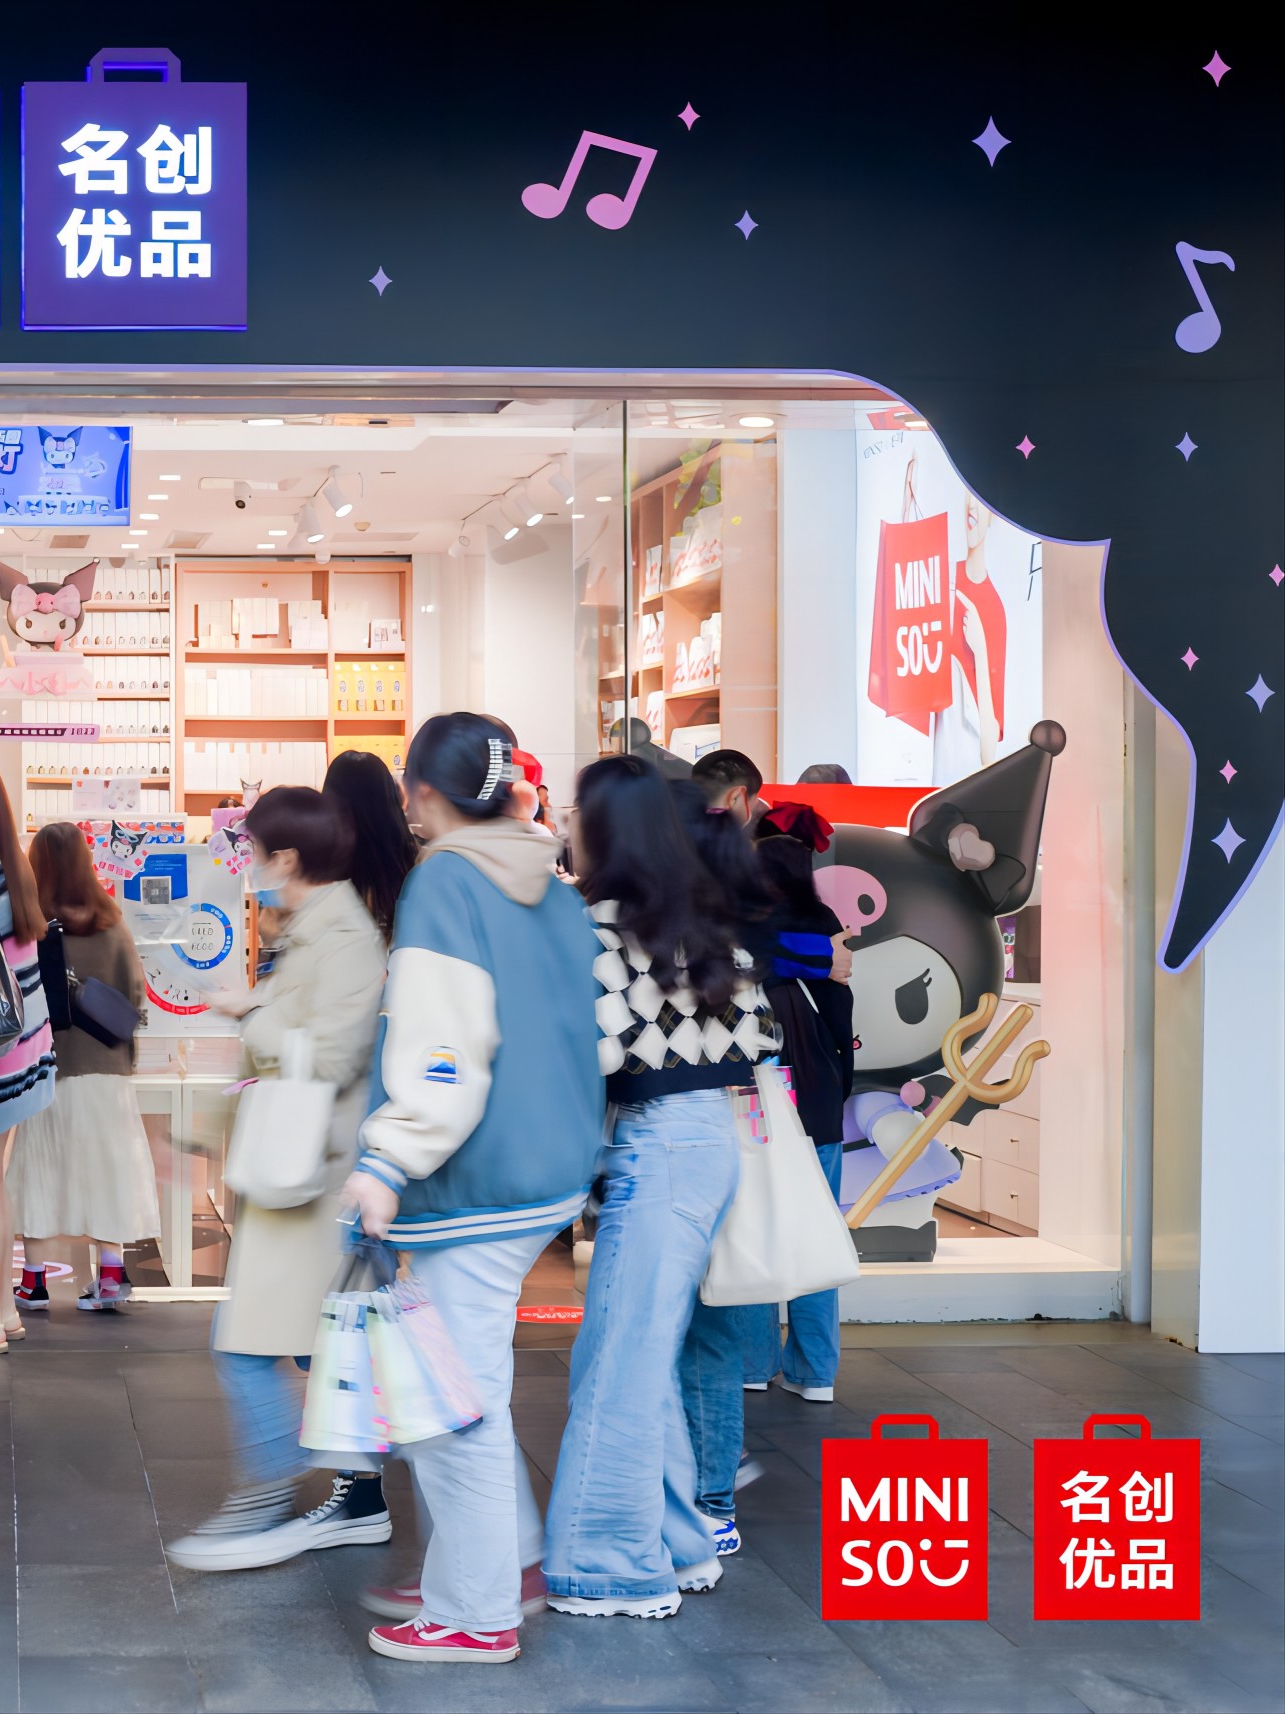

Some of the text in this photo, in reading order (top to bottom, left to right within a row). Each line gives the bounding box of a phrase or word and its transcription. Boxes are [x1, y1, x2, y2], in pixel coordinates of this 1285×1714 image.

[58, 122, 213, 195] 名创
[56, 207, 213, 279] 优品
[894, 555, 942, 610] MINI
